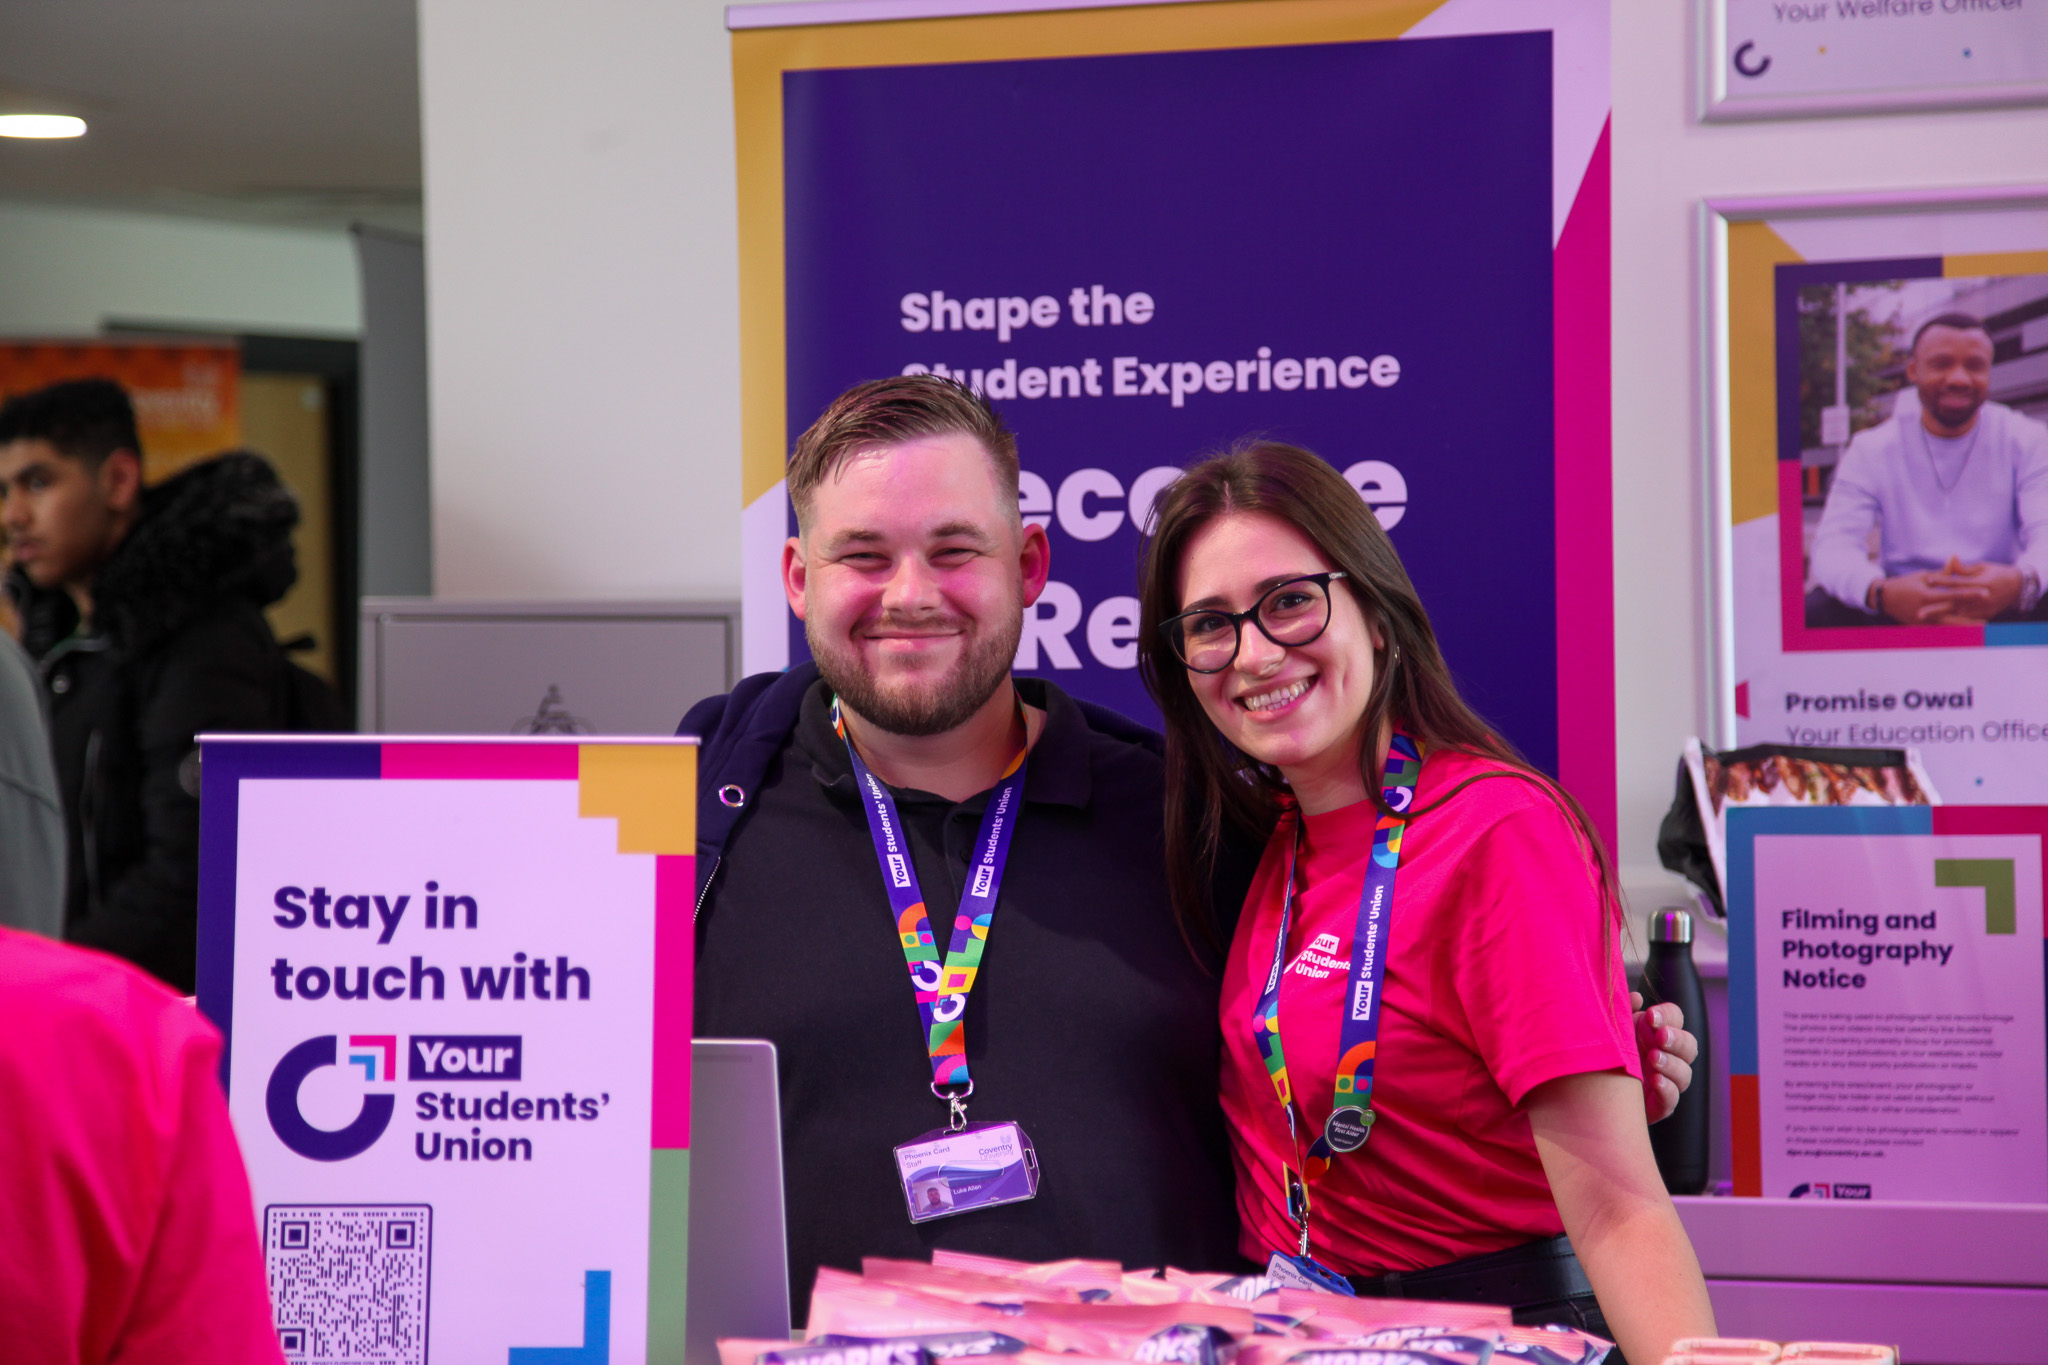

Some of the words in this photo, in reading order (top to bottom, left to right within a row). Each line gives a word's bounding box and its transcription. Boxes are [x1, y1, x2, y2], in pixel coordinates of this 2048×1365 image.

[1773, 2, 1828, 23] Your
[1836, 0, 1934, 19] Welfare
[901, 291, 1060, 342] Shape
[1069, 285, 1155, 325] the
[1113, 346, 1401, 407] Experience
[1785, 688, 1896, 712] Promise
[1903, 686, 1973, 710] Owai
[1786, 726, 1841, 744] Your
[1849, 720, 1975, 744] Education
[865, 773, 883, 799] Union
[996, 787, 1013, 815] Union
[273, 885, 411, 945] Stay
[424, 881, 479, 929] in
[1370, 885, 1385, 919] Union
[1781, 908, 1880, 936] Filming
[1884, 910, 1937, 930] and
[1782, 940, 1954, 966] Photography
[270, 955, 446, 1001] touch
[460, 952, 592, 1001] with
[1295, 963, 1330, 979] Union
[1782, 968, 1867, 989] Notice
[415, 1041, 514, 1075] Your
[415, 1127, 533, 1162] Union
[904, 1150, 932, 1161] Phoenix
[933, 1146, 951, 1155] Card
[978, 1143, 1013, 1156] Coventry
[906, 1159, 922, 1168] Staff
[953, 1187, 967, 1195] Luke
[967, 1184, 982, 1192] Allen
[1835, 1185, 1869, 1198] Your
[1272, 1270, 1286, 1281] Staff
[1275, 1262, 1298, 1280] Phoenix
[1298, 1276, 1313, 1288] Card
